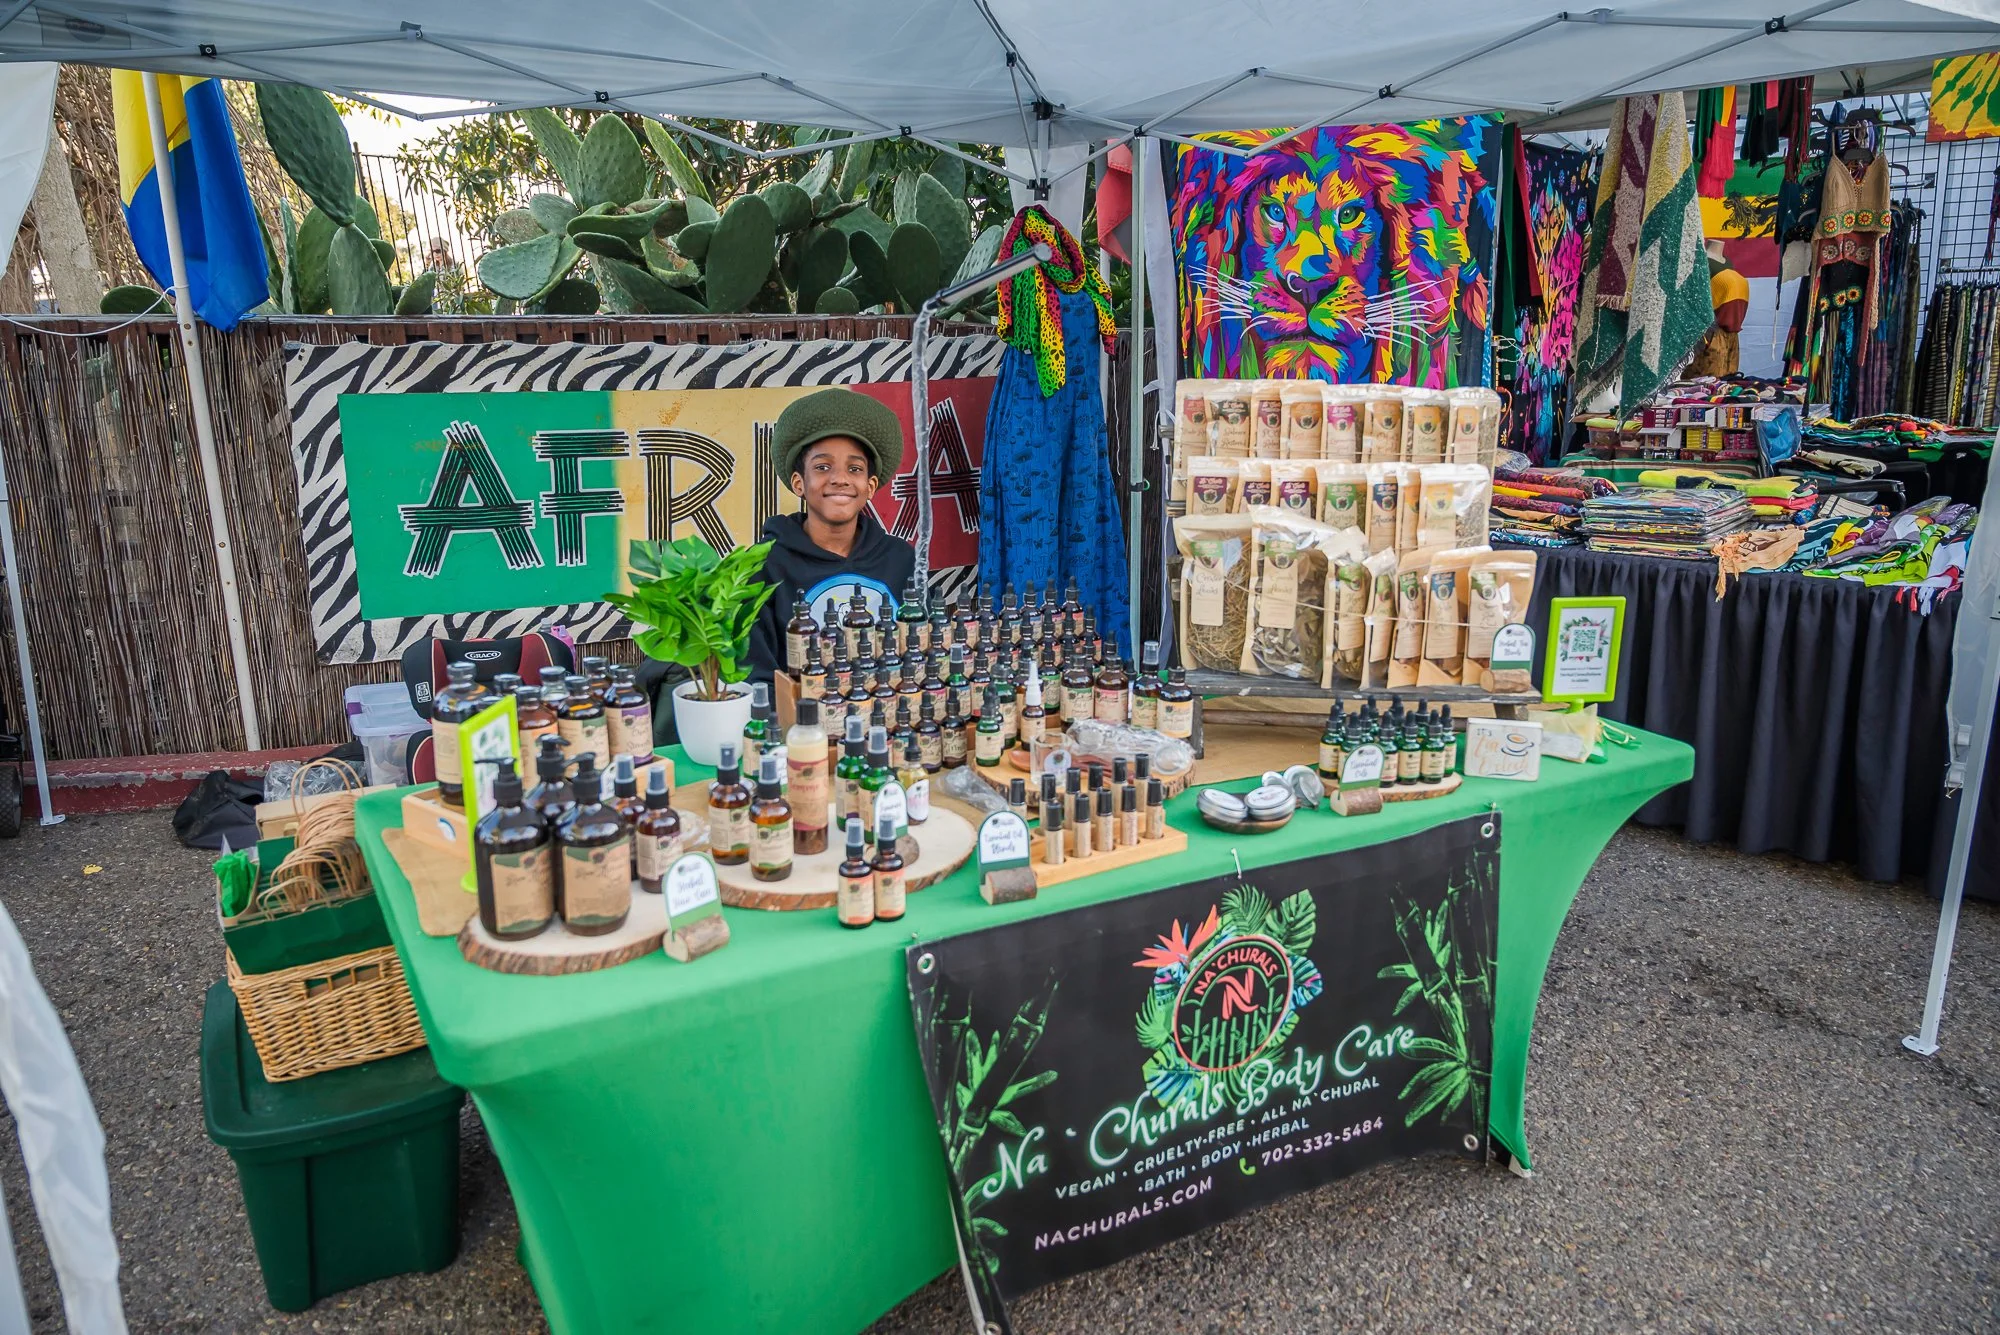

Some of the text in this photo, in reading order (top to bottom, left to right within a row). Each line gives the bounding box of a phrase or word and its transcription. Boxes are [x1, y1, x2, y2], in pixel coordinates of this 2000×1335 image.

[398, 397, 982, 578] AFRIA
[469, 651, 499, 659] GRACO
[1236, 1047, 1324, 1115] Body
[1335, 1024, 1415, 1077] Care
[1055, 1171, 1116, 1199] VEGAN
[1261, 1105, 1288, 1125] ALL
[1201, 1141, 1242, 1169] BODY
[1261, 1116, 1385, 1167] 702-332-5484
[1034, 1186, 1213, 1251] NACHURALS.COM
